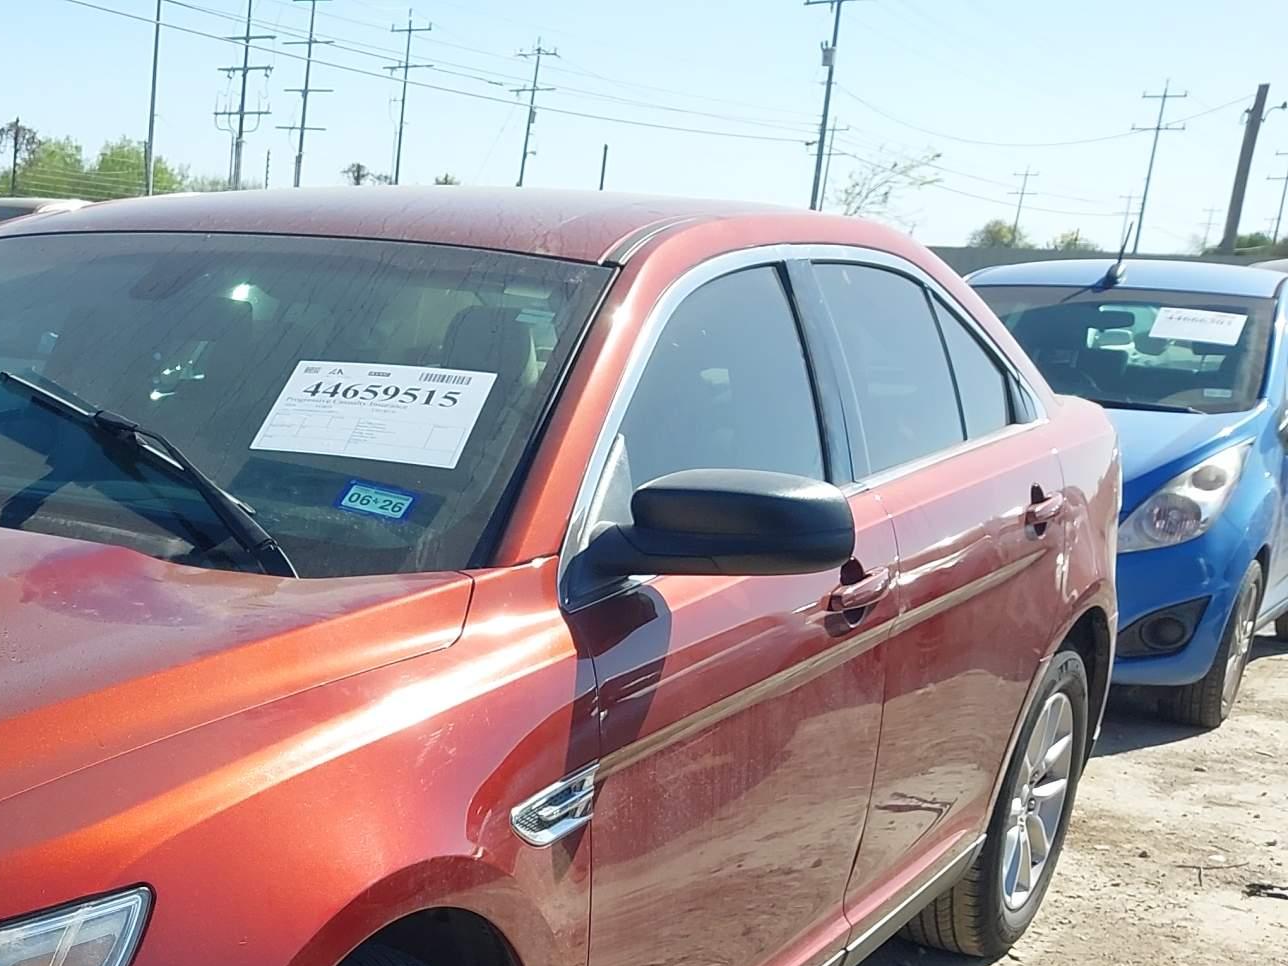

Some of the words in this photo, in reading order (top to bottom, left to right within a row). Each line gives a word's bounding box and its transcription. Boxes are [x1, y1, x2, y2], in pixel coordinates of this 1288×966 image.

[303, 381, 461, 407] 44659515
[348, 492, 374, 506] 06
[378, 499, 405, 513] 26
